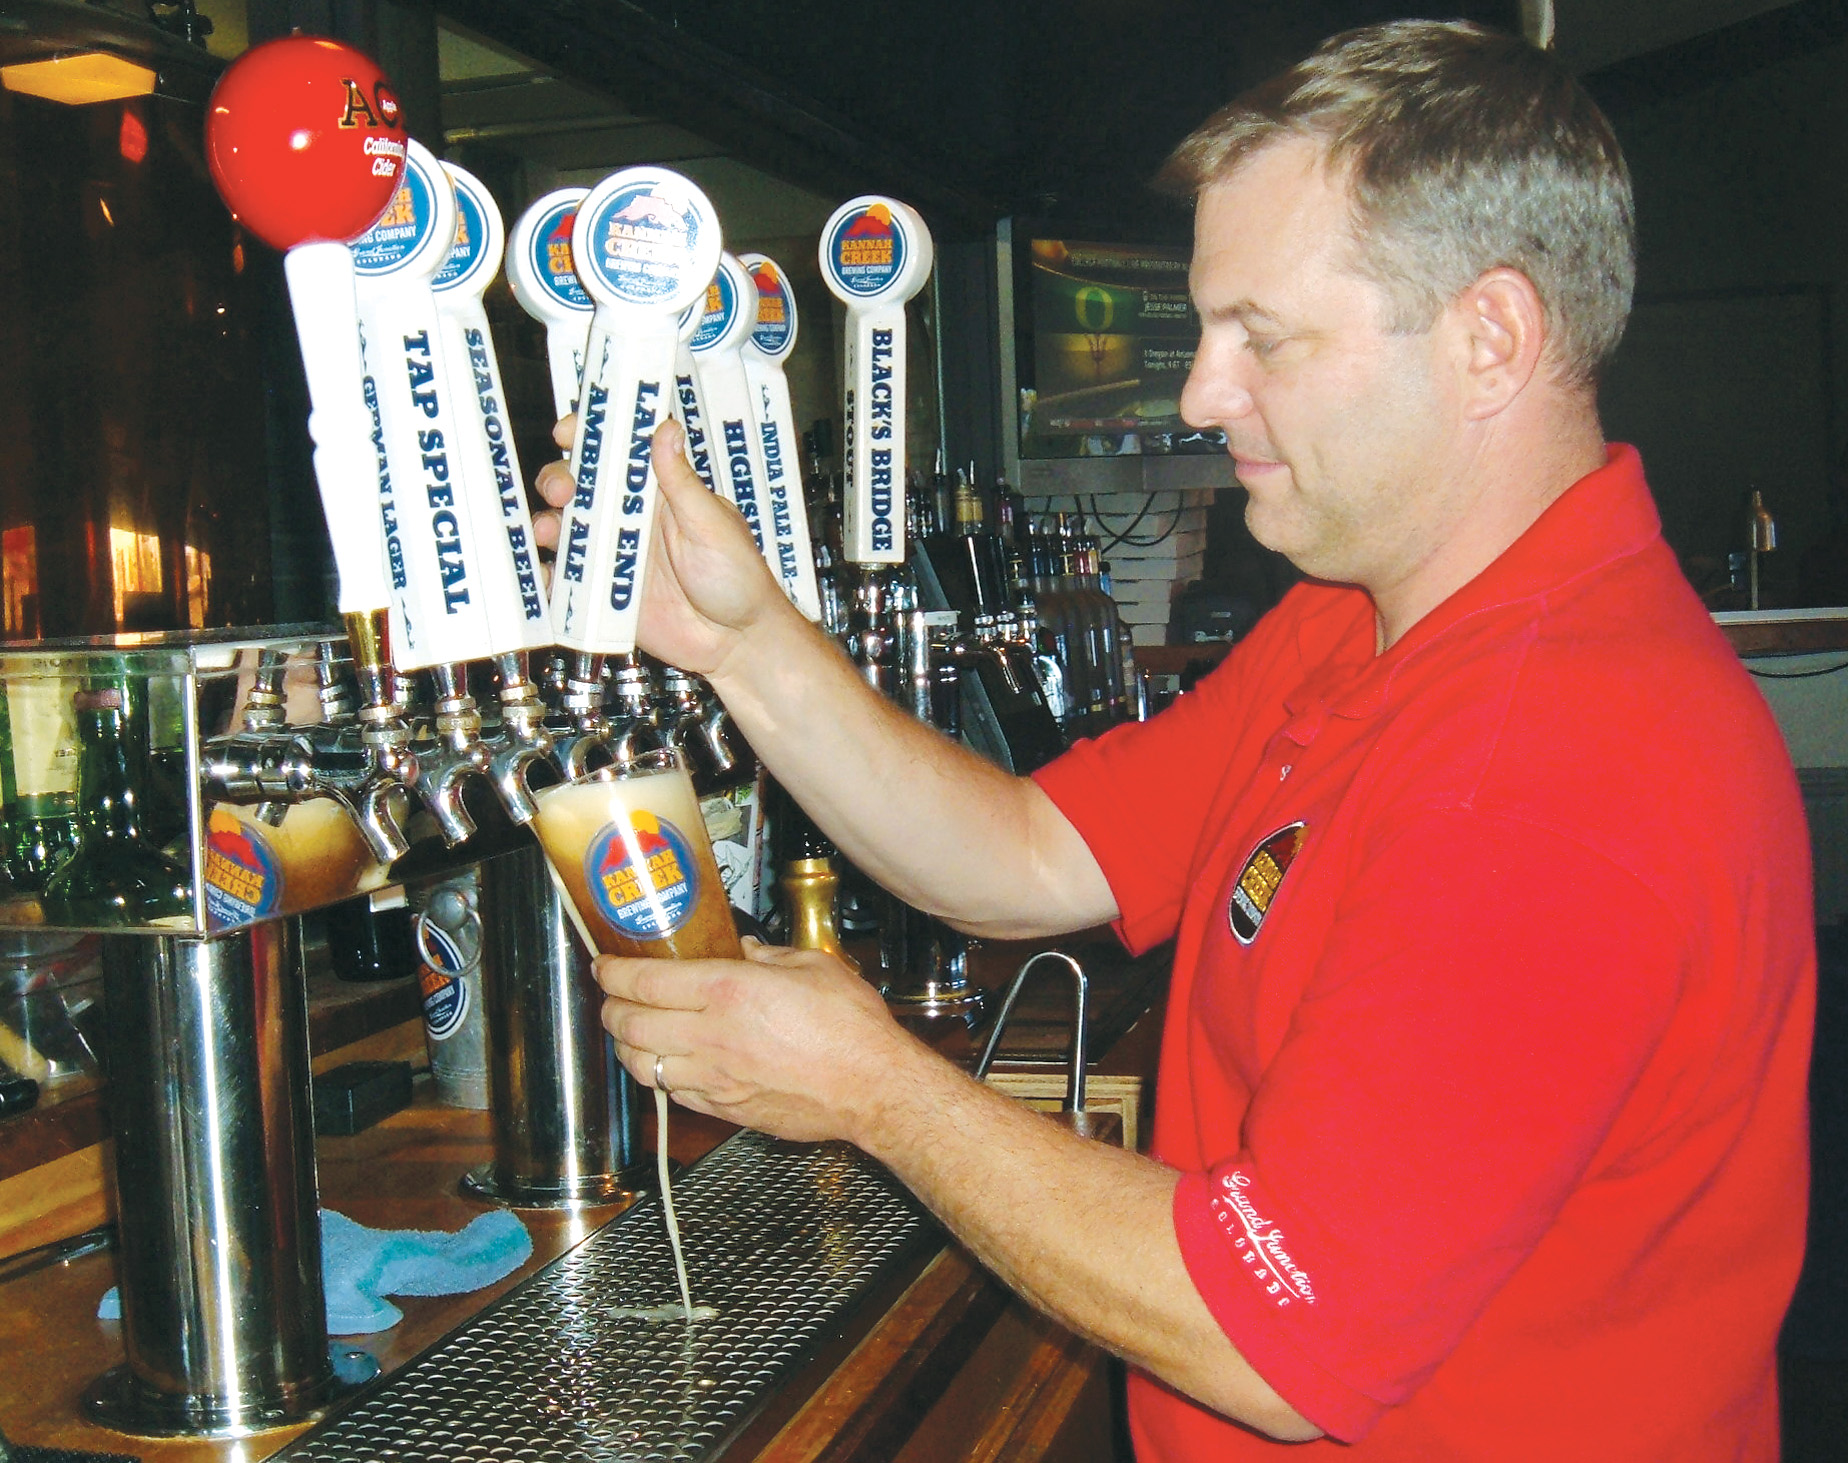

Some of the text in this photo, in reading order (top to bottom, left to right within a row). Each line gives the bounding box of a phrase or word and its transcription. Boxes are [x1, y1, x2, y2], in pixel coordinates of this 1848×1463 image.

[372, 158, 396, 176] Cider
[374, 226, 417, 243] COMPANY
[450, 246, 471, 259] PANY
[840, 250, 892, 265] CREEK
[871, 328, 893, 551] BLACK'S BRIDGE
[403, 329, 471, 615] TAP SPECIAL
[464, 327, 543, 621] SEASONAL BEER
[563, 381, 610, 584] AMBER ALE
[610, 379, 660, 612] LANDS END
[760, 421, 798, 579] INDIA PALE ALE
[380, 500, 408, 590] LAGER
[602, 848, 677, 890] KANAH
[608, 861, 684, 908] CREK
[616, 898, 653, 920] BREWIN
[655, 881, 689, 903] OMPANY
[1222, 1171, 1273, 1232] Grand
